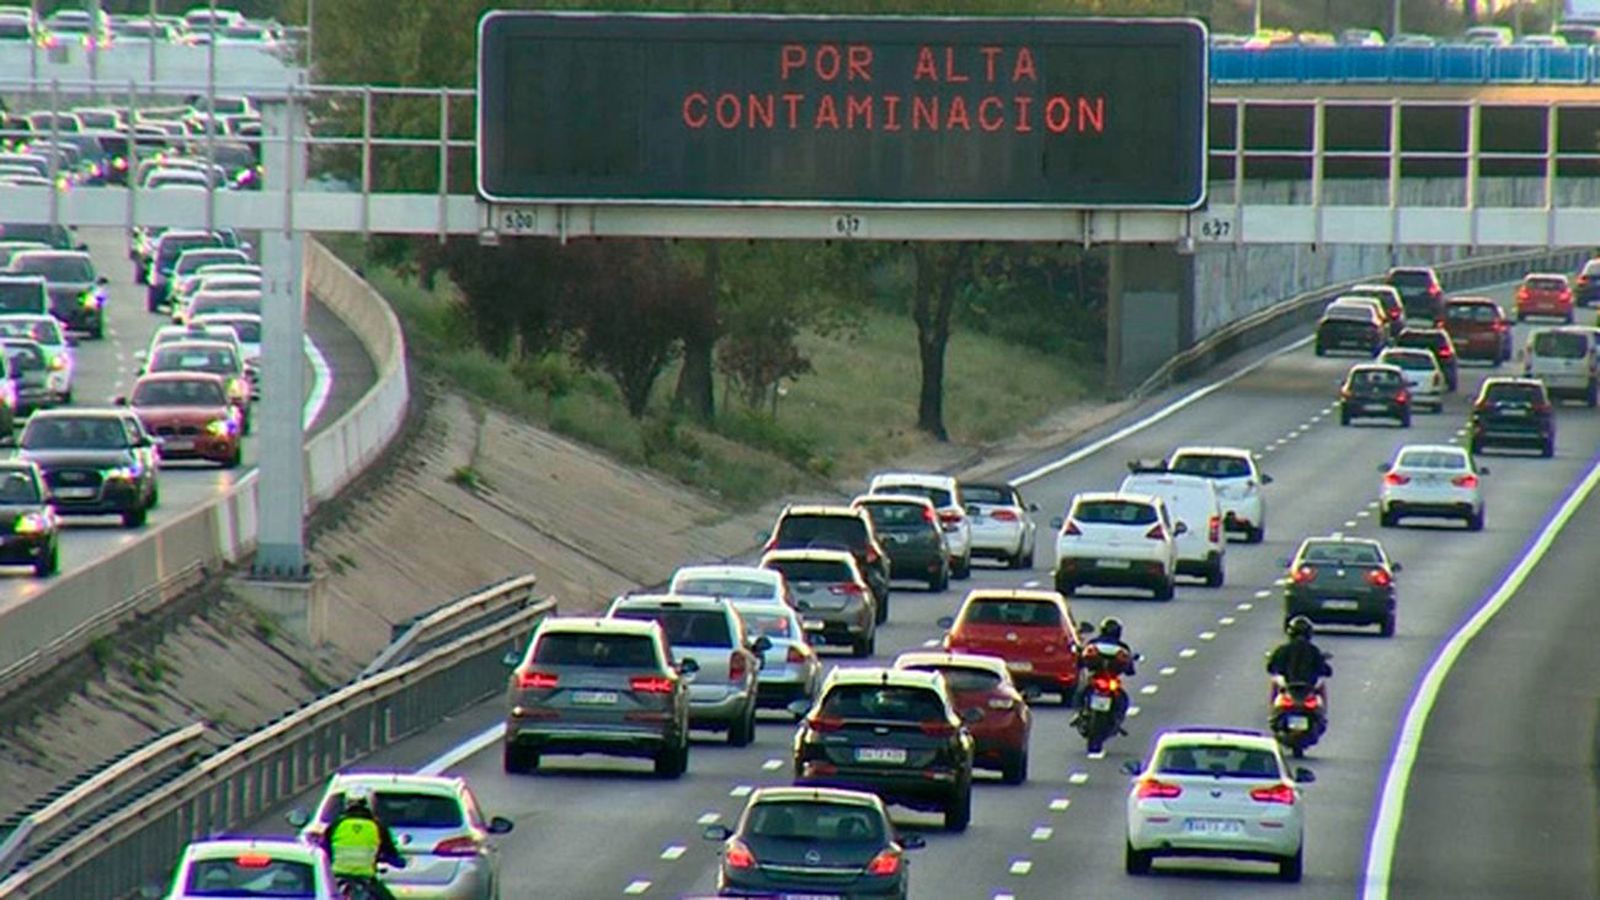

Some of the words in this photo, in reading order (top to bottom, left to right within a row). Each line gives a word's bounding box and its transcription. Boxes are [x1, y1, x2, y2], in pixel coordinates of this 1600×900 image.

[781, 46, 874, 81] POR
[914, 47, 1037, 82] ALTA
[682, 93, 1105, 133] CONTAMINACION
